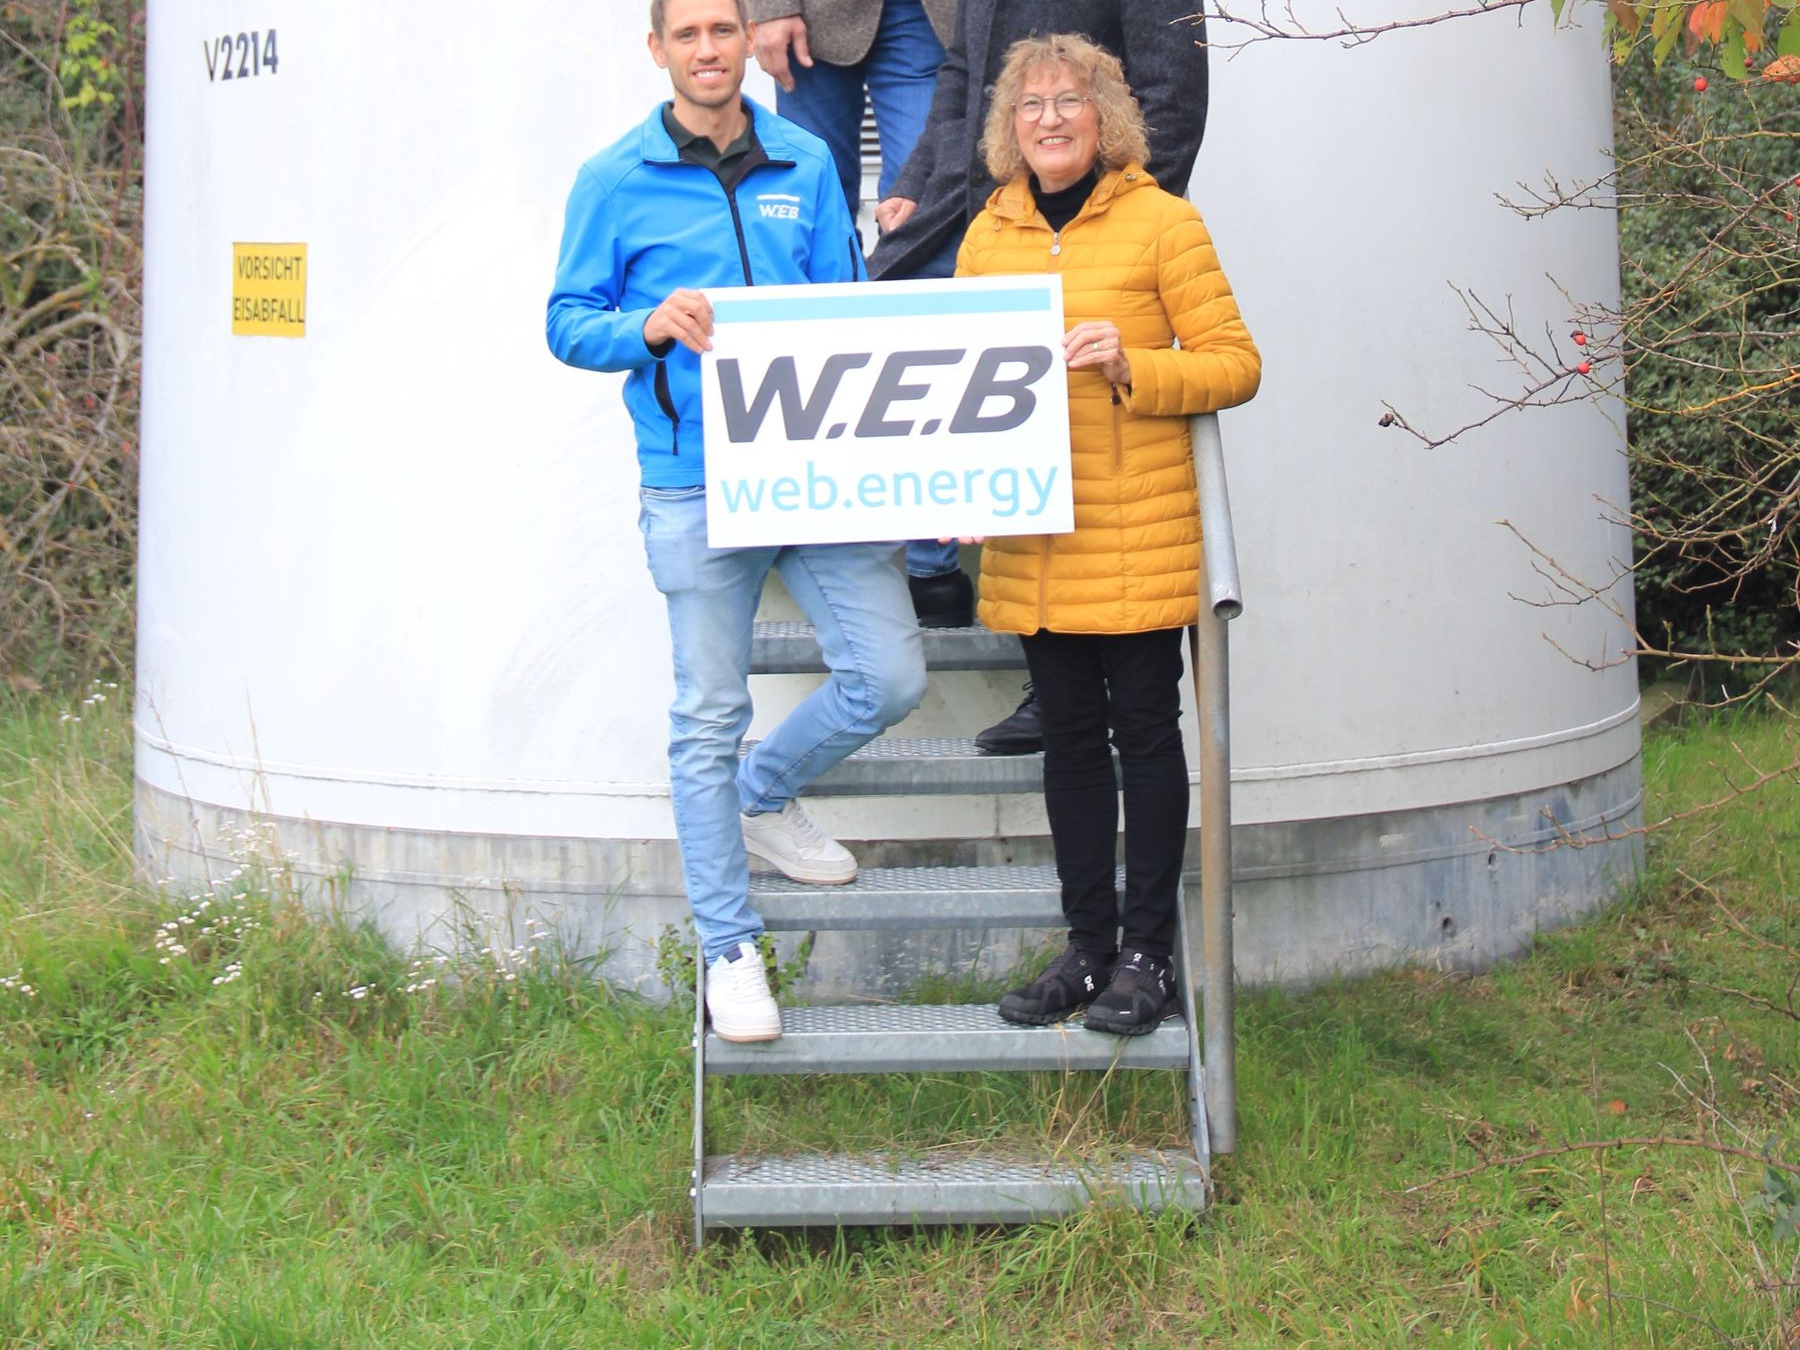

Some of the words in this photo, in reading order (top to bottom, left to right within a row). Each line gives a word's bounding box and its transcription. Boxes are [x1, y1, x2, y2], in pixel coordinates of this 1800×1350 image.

[203, 28, 279, 82] V2214
[237, 255, 303, 281] VORSICHT
[233, 297, 305, 324] EISABFALL
[716, 345, 1053, 443] W.E.B
[720, 461, 1059, 517] web.energy
